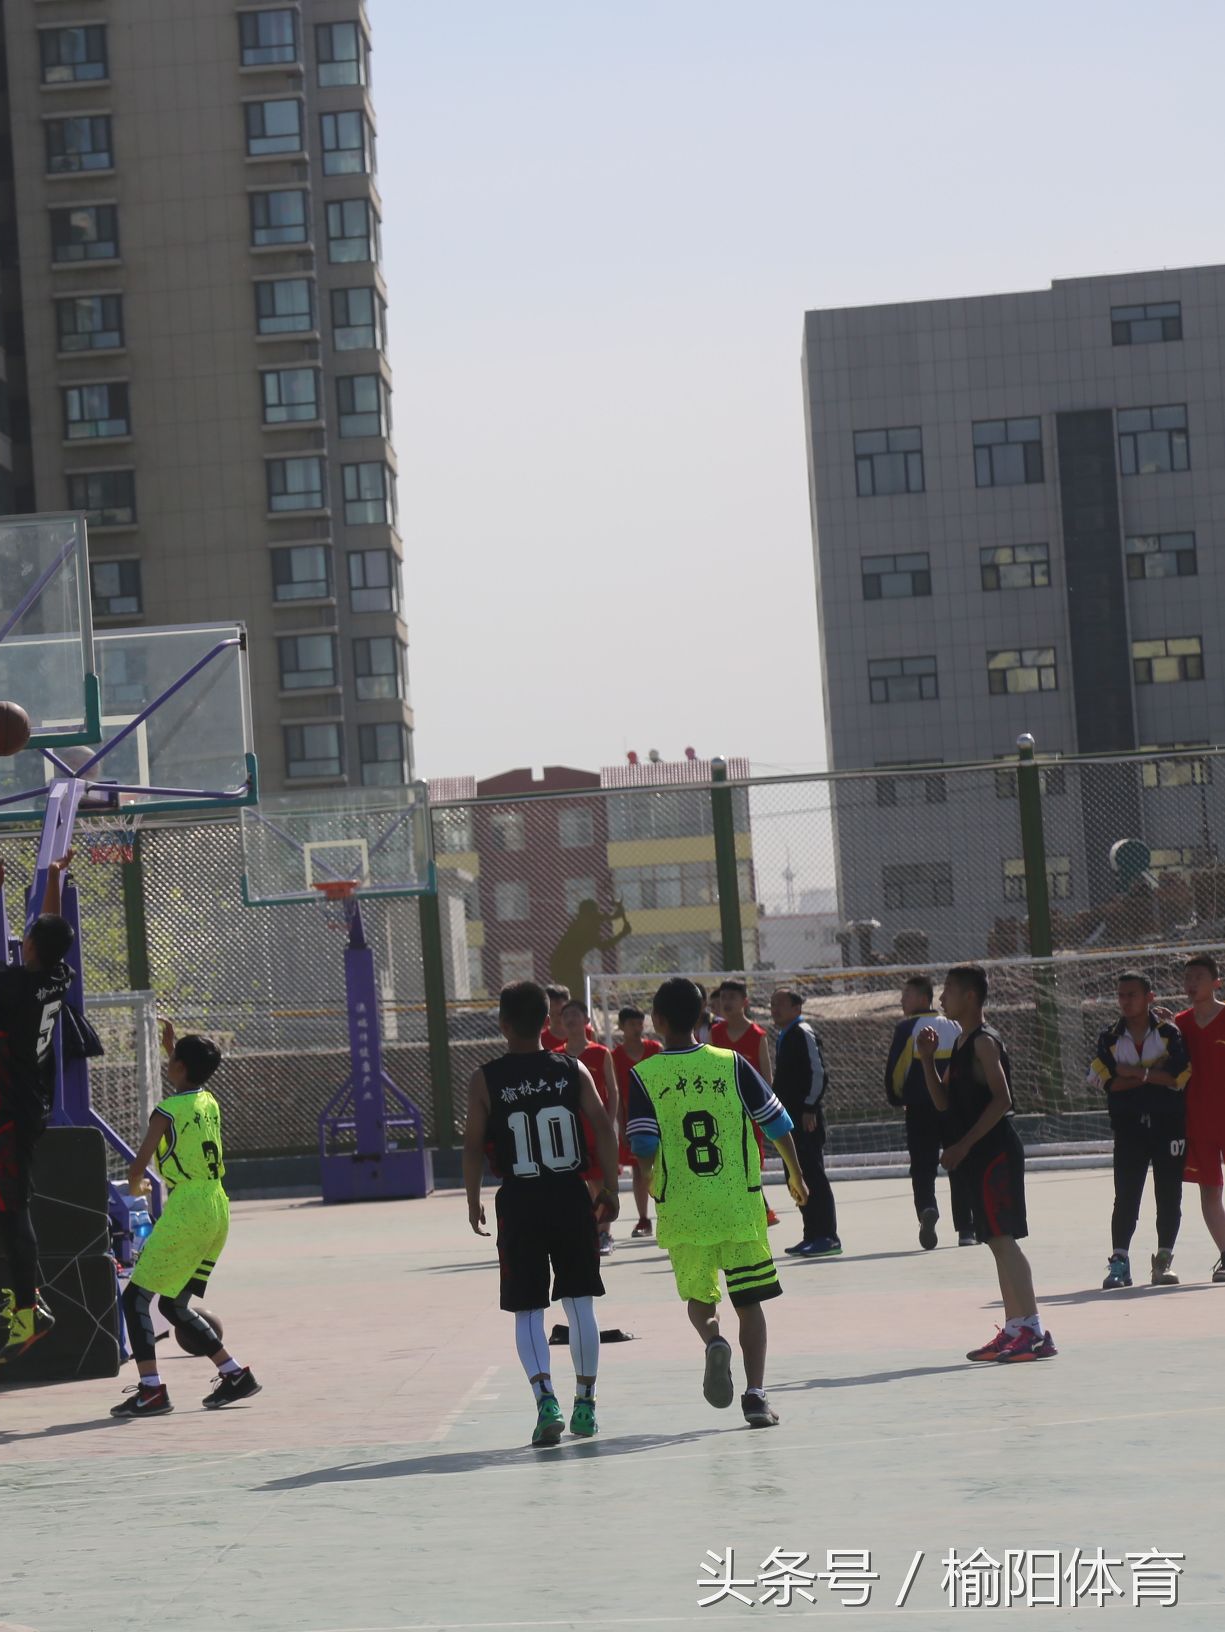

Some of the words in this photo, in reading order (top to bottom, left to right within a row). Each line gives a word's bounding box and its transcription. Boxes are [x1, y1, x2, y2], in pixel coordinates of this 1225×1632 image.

[36, 1000, 62, 1063] 5
[500, 1077, 569, 1104] 榆林六中
[507, 1105, 582, 1178] 10
[682, 1110, 724, 1178] 8
[1170, 1139, 1186, 1157] 07
